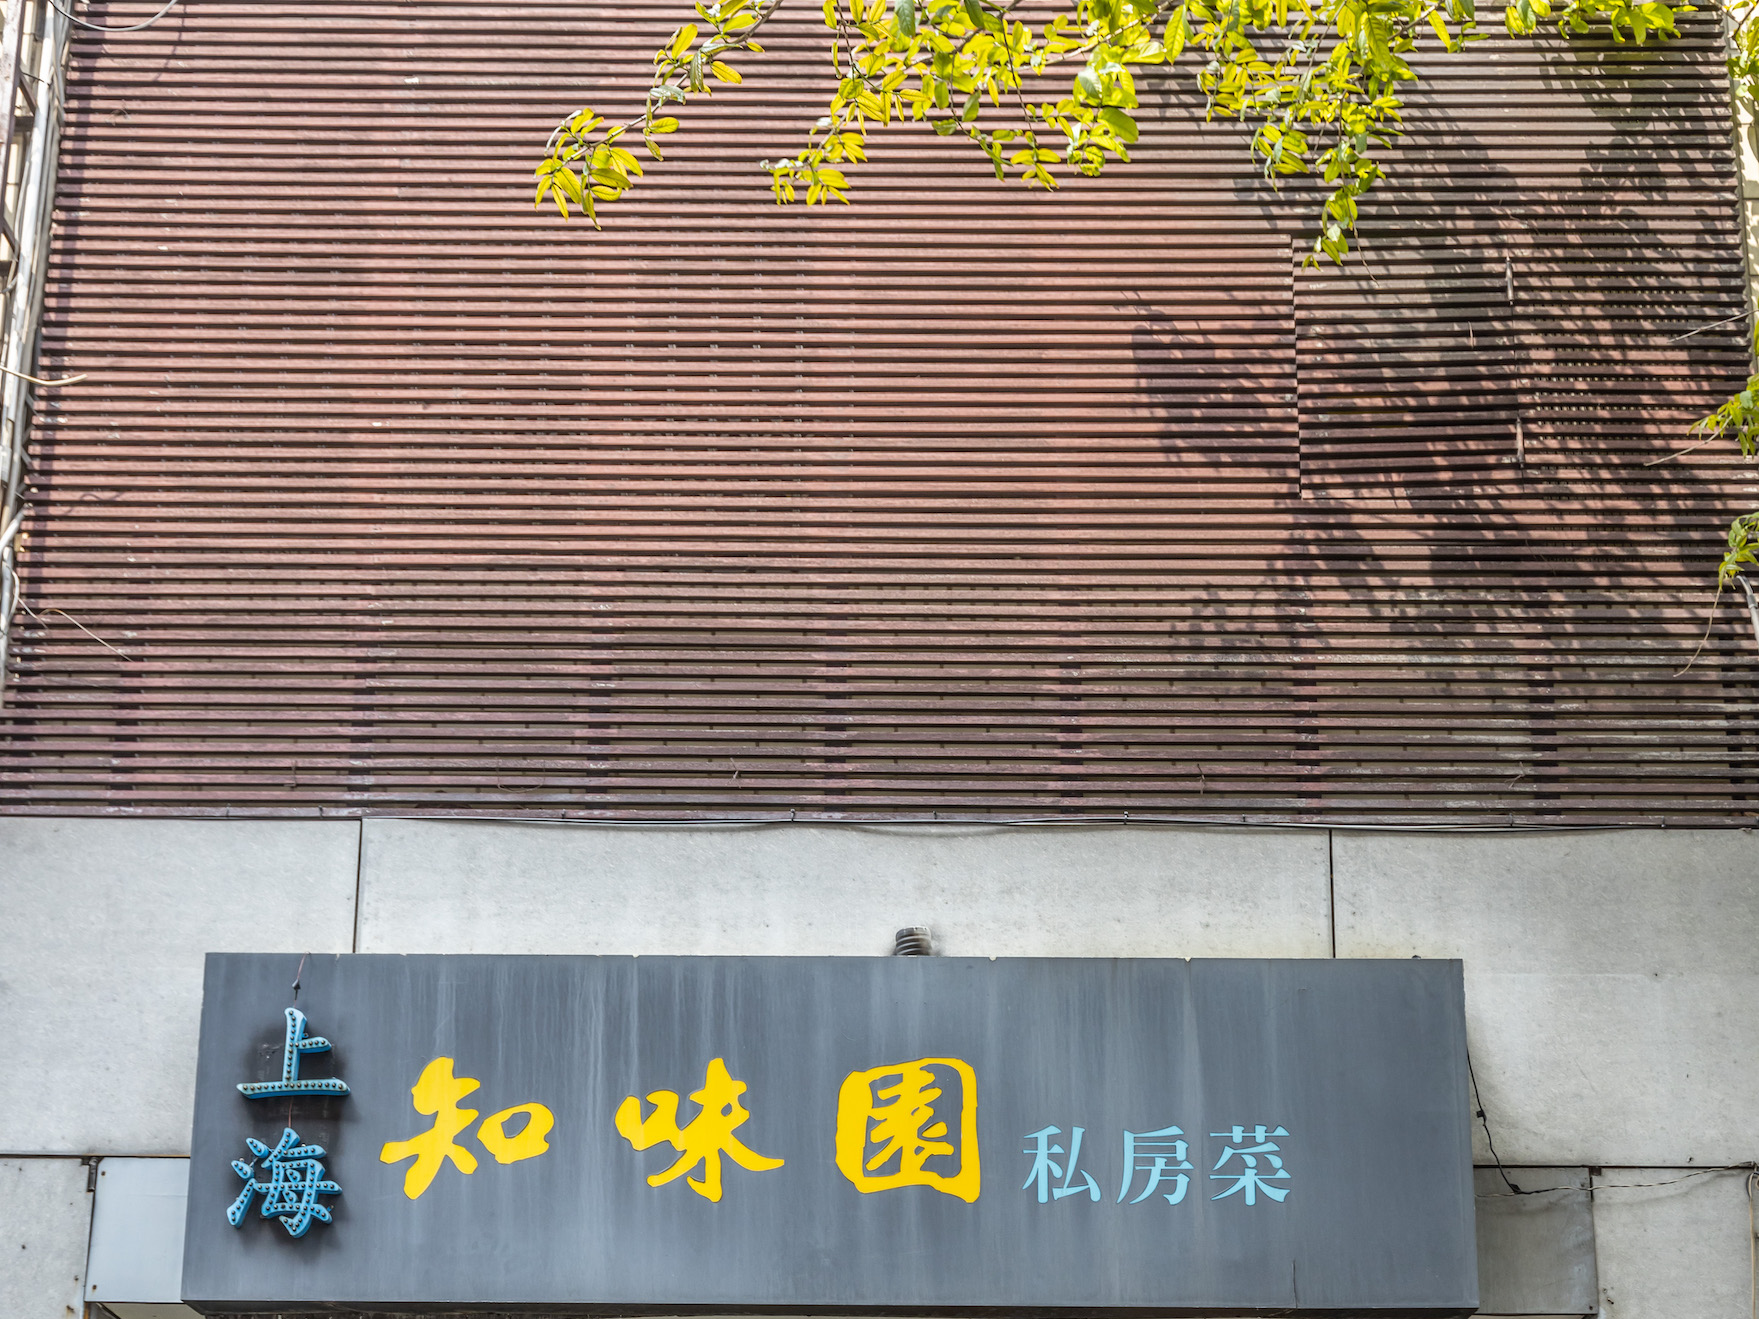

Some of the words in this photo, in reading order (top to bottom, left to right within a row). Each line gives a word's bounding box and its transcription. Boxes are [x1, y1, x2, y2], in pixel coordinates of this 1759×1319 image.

[227, 1005, 351, 1239] 上海
[380, 1057, 980, 1203] 知味園
[1022, 1125, 1291, 1205] 私房菜
